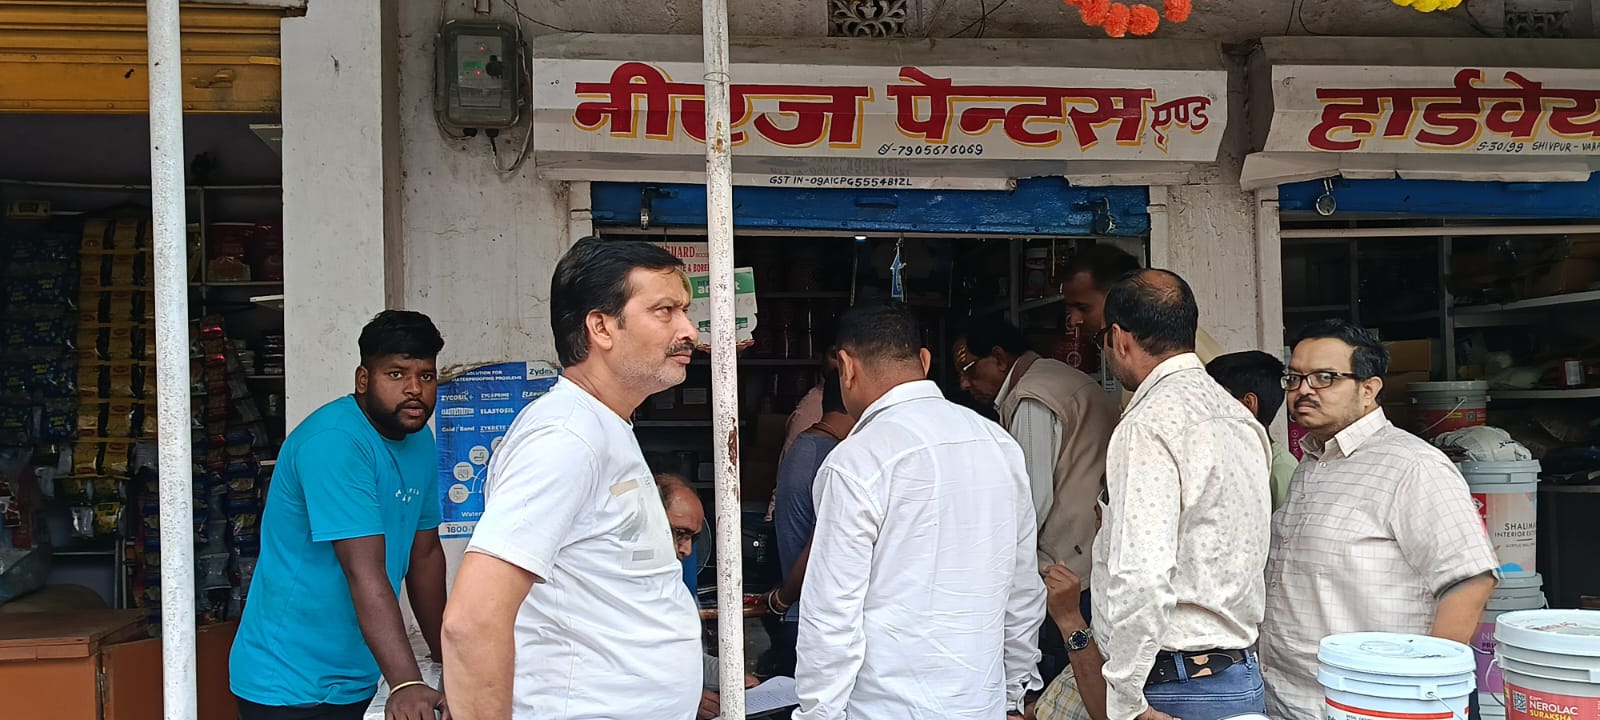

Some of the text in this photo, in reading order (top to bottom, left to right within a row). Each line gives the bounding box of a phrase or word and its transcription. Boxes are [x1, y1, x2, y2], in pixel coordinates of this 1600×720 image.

[1151, 96, 1212, 151] एण्ड
[1531, 141, 1572, 152] SHIVPUR
[769, 175, 790, 185] GST
[1529, 701, 1579, 715] NEROLAC
